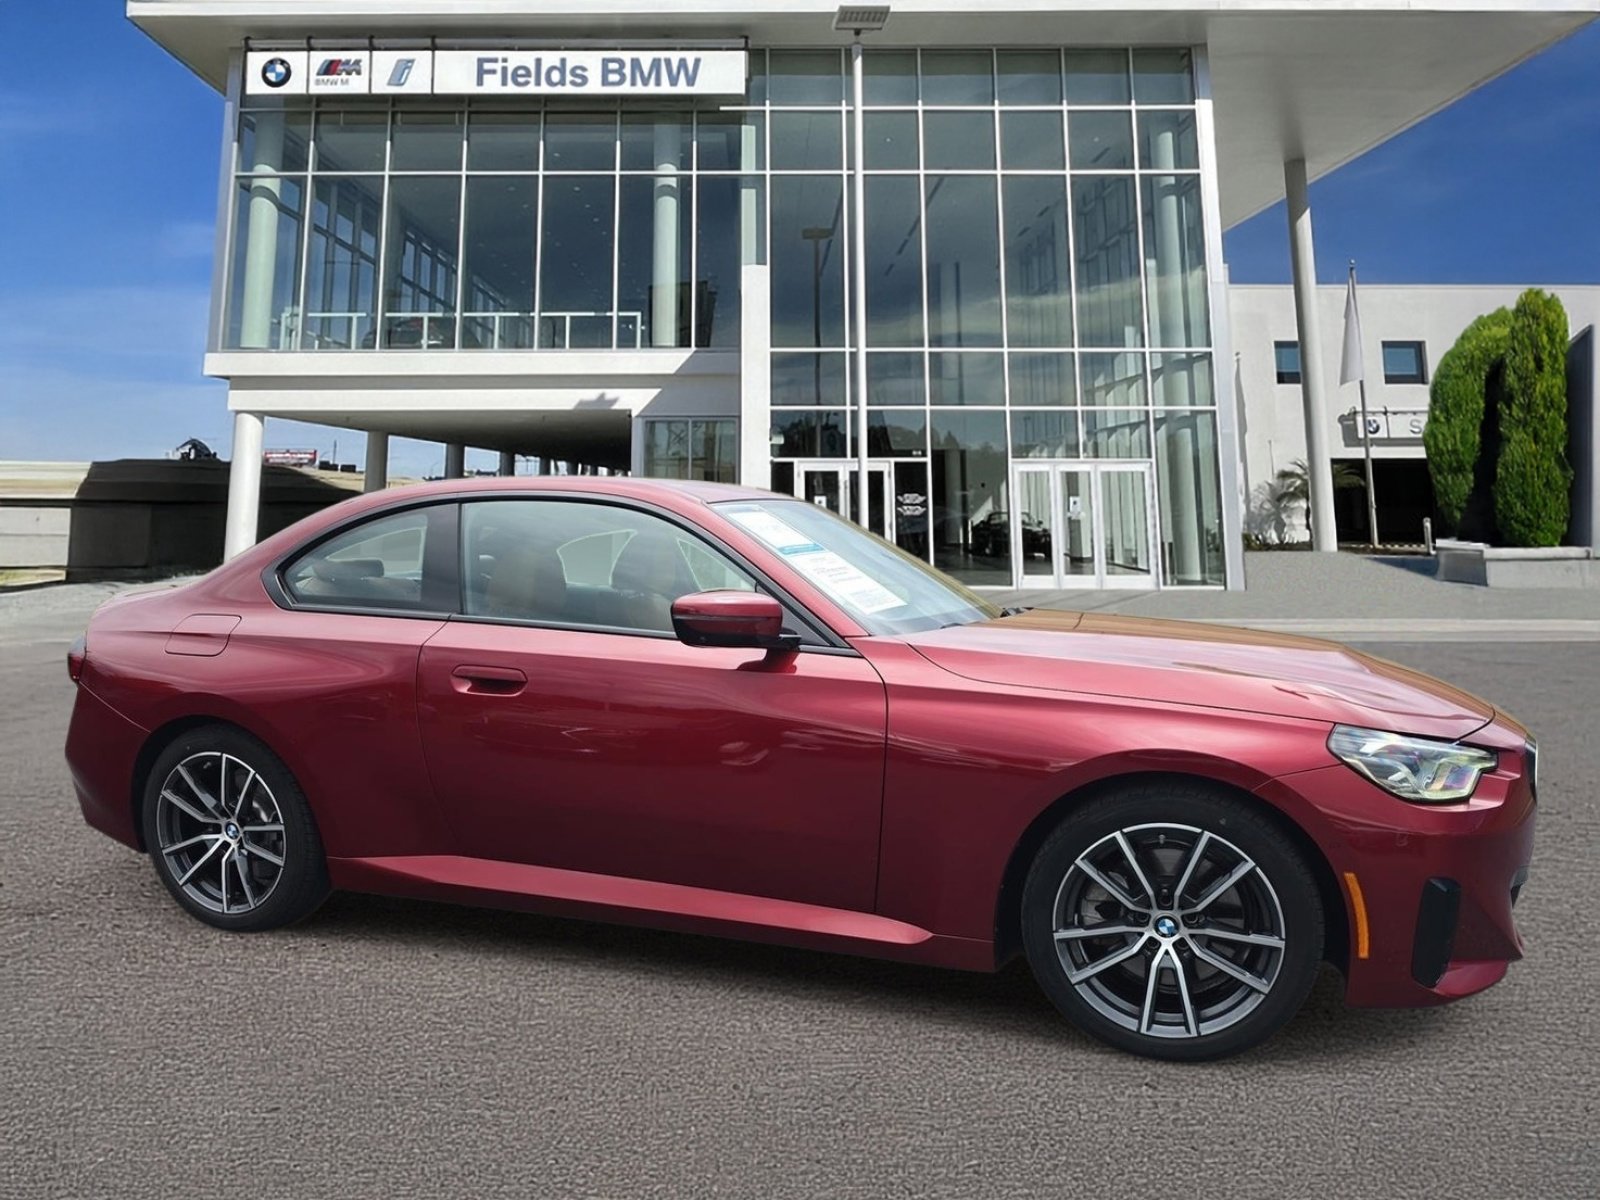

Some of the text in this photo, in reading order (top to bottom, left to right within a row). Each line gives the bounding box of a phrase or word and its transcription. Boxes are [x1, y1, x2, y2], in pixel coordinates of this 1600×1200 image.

[476, 57, 702, 87] Fields BMW
[315, 78, 339, 86] BMW
